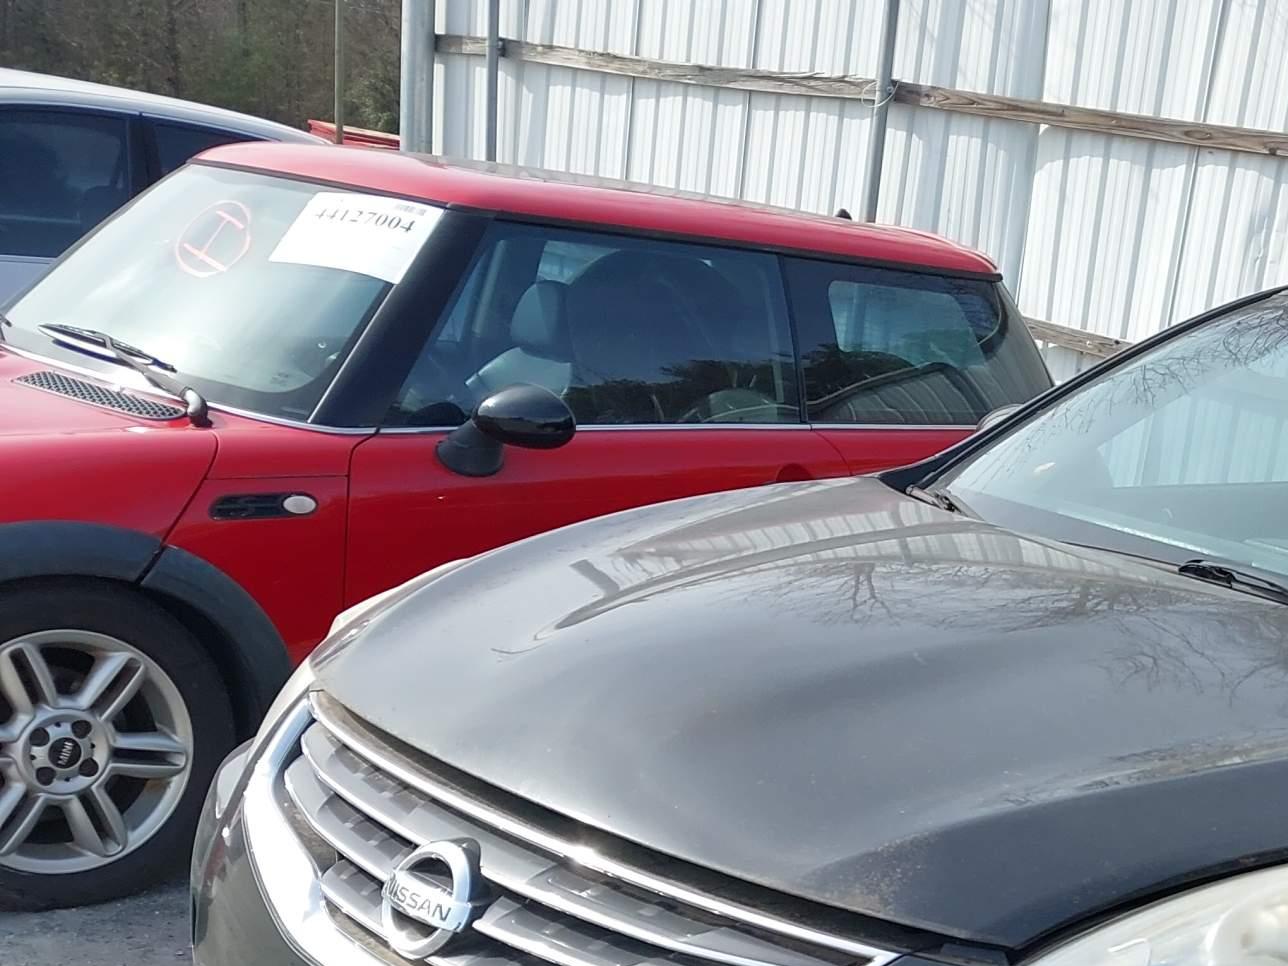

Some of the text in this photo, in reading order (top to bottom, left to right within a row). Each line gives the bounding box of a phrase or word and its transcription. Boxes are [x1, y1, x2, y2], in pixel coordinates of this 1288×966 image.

[315, 207, 416, 233] 44127004
[57, 741, 74, 766] MINI
[384, 871, 452, 922] NISSAN
